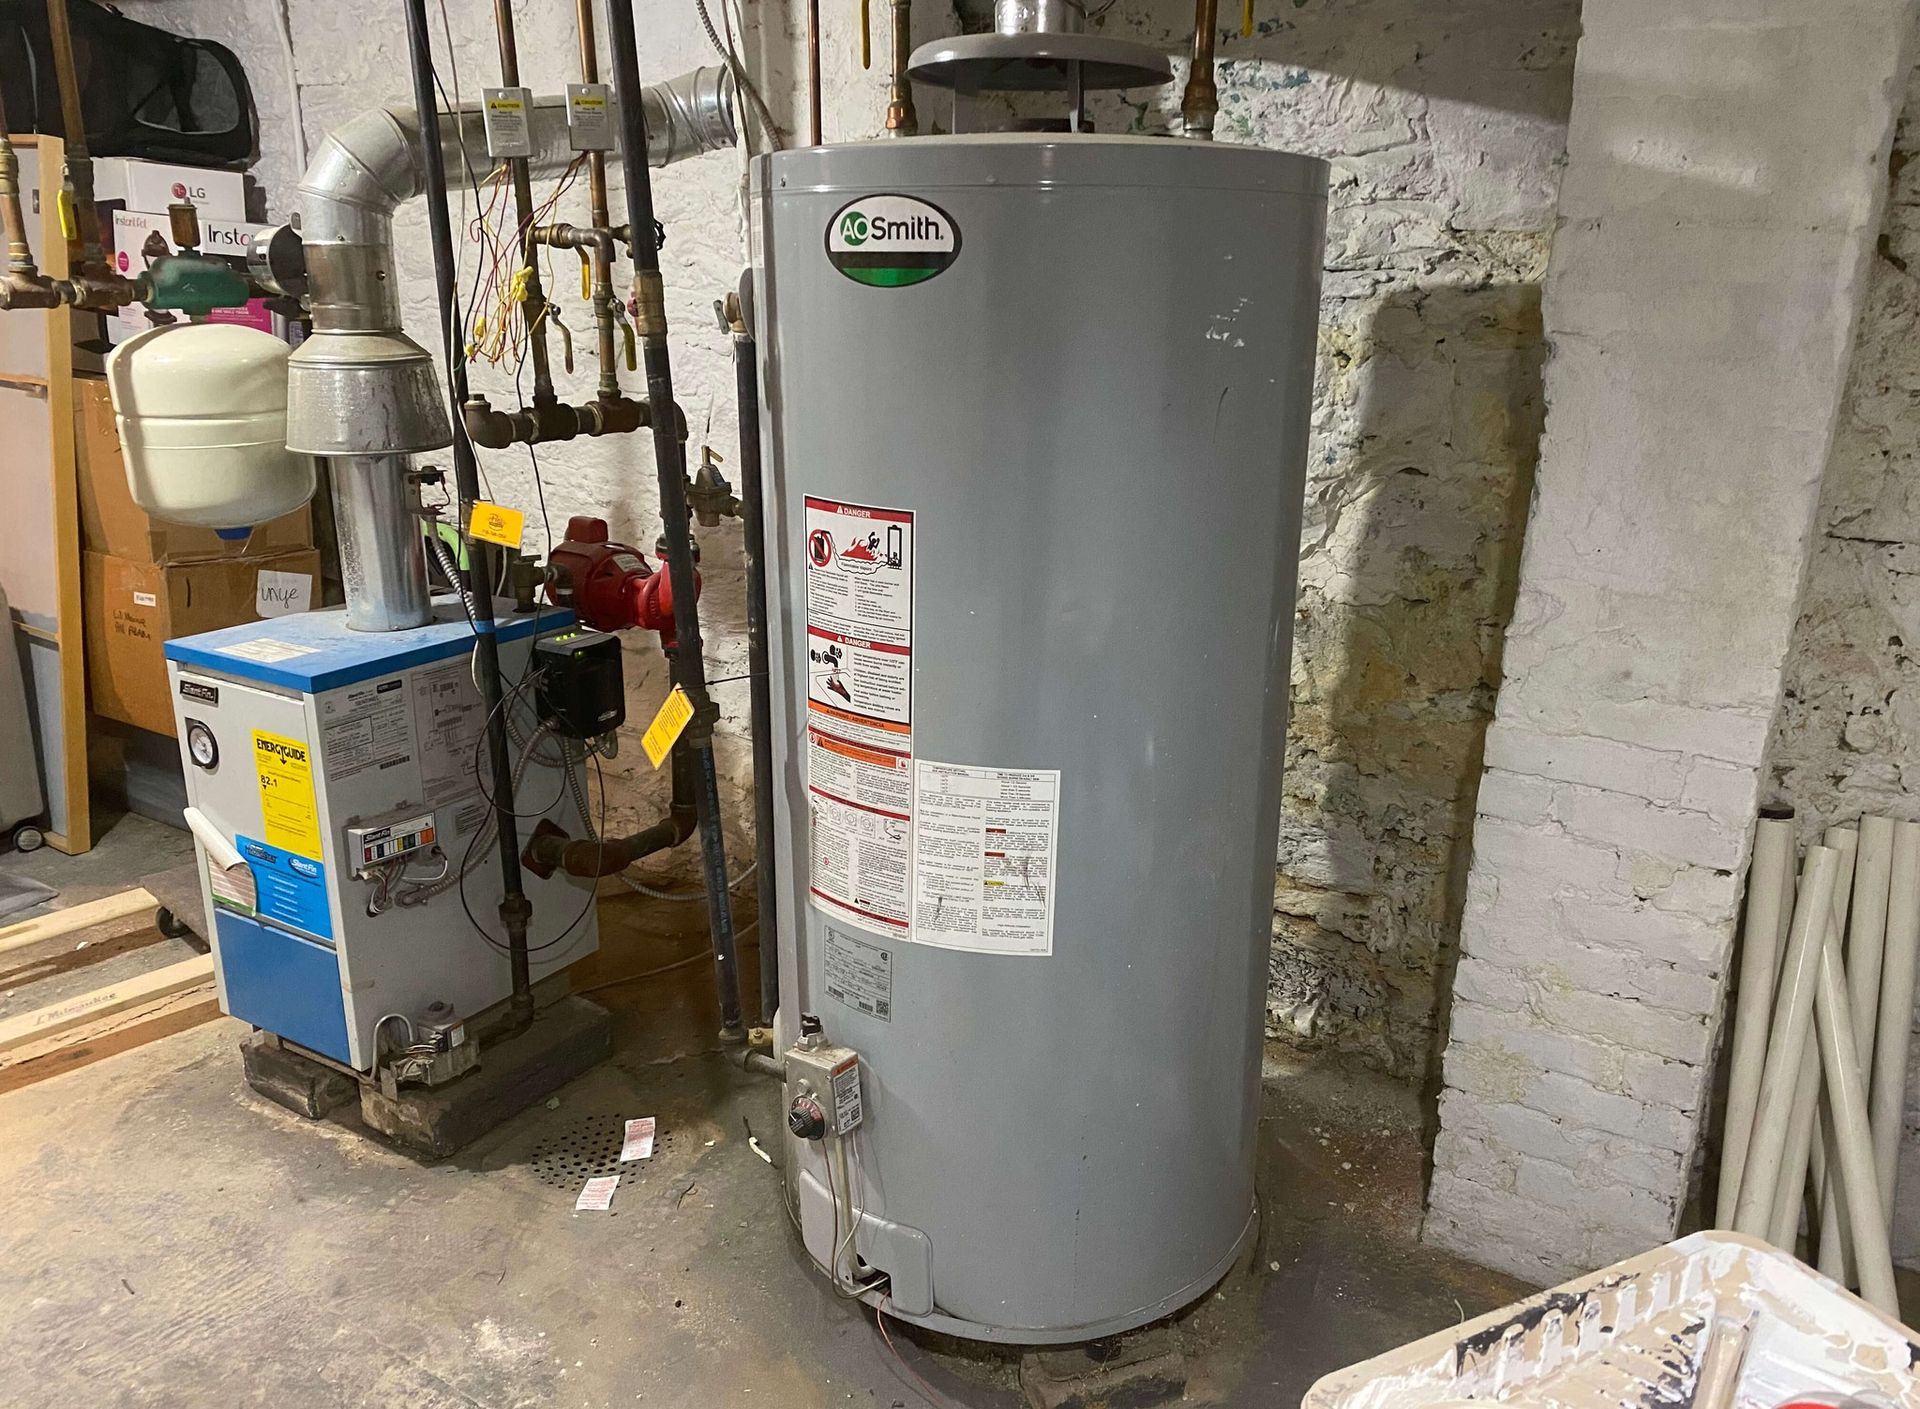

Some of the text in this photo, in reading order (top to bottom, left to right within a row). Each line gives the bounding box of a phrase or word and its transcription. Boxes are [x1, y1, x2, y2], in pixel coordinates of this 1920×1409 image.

[189, 187, 206, 198] LG
[843, 507, 871, 518] DANGER
[844, 637, 871, 648] DANGER
[261, 775, 277, 787] 82.1
